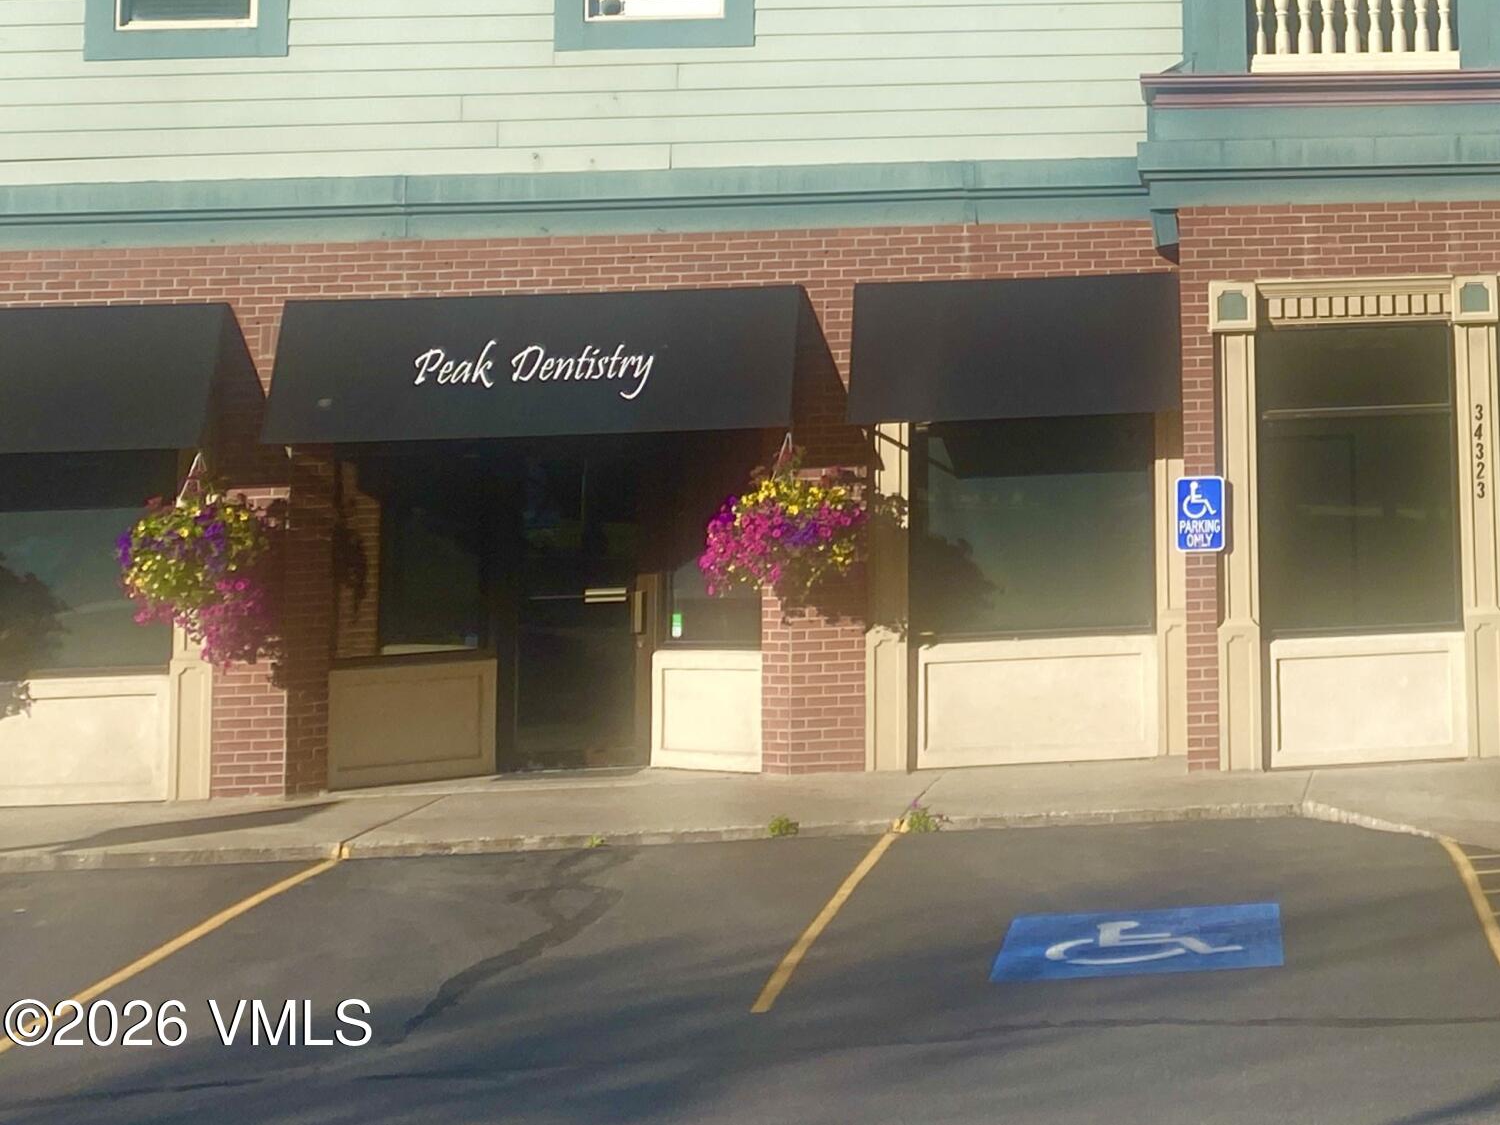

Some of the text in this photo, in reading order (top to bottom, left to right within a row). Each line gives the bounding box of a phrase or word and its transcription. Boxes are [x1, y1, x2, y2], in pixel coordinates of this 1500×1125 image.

[414, 339, 655, 400] Peak Dentistry
[1473, 403, 1486, 499] 34323
[1179, 519, 1221, 534] PARKING
[1186, 533, 1214, 548] ONLY
